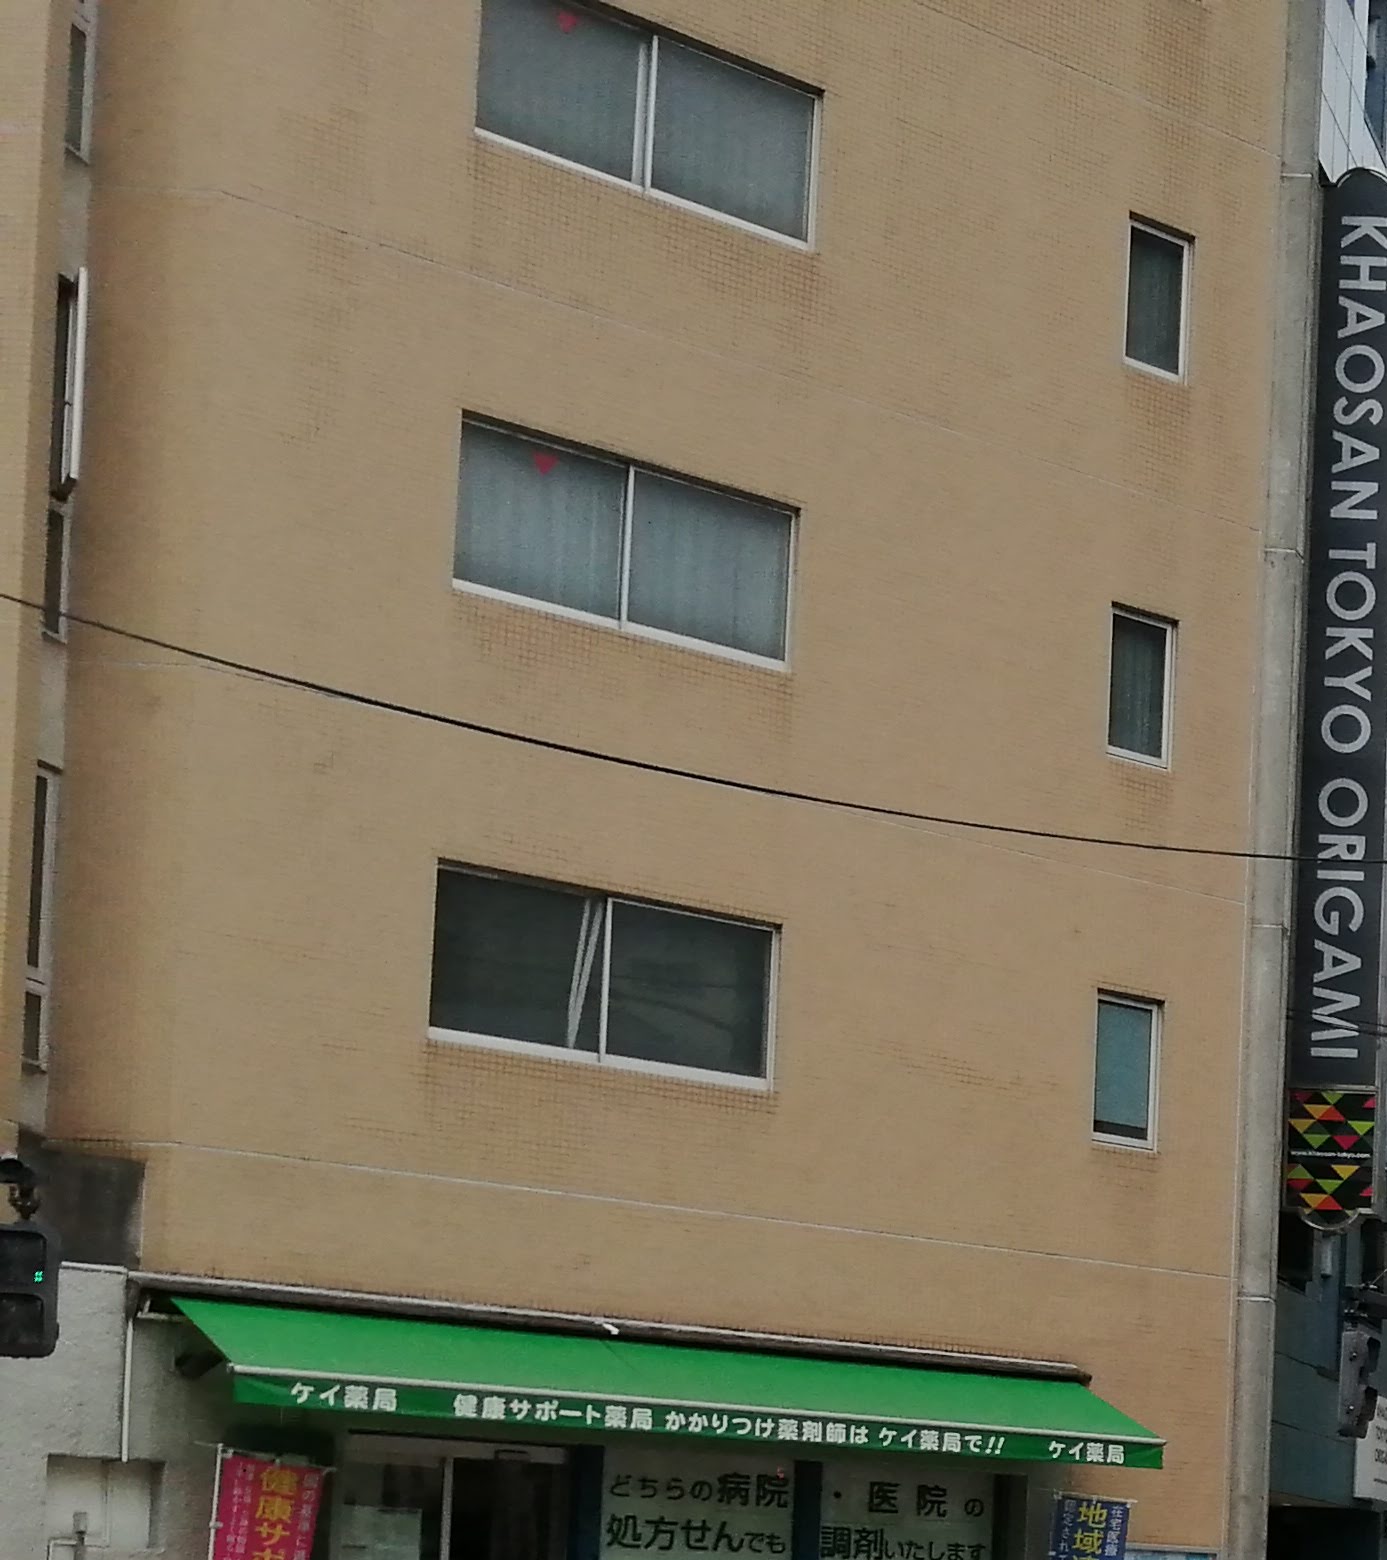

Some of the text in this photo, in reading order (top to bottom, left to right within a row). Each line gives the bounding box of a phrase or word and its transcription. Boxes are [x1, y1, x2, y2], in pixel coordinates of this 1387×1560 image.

[1321, 542, 1377, 753] TOKYO
[1310, 777, 1369, 1059] ORIGAMI
[290, 1382, 398, 1413] ケイ薬局
[453, 1393, 653, 1431] 健康サポート薬局
[664, 1410, 869, 1445] かかりつけ薬剤師は
[1047, 1440, 1126, 1465] ケイ薬局
[608, 1471, 791, 1510] どちらの病院
[606, 1513, 787, 1554] 処方せんでも
